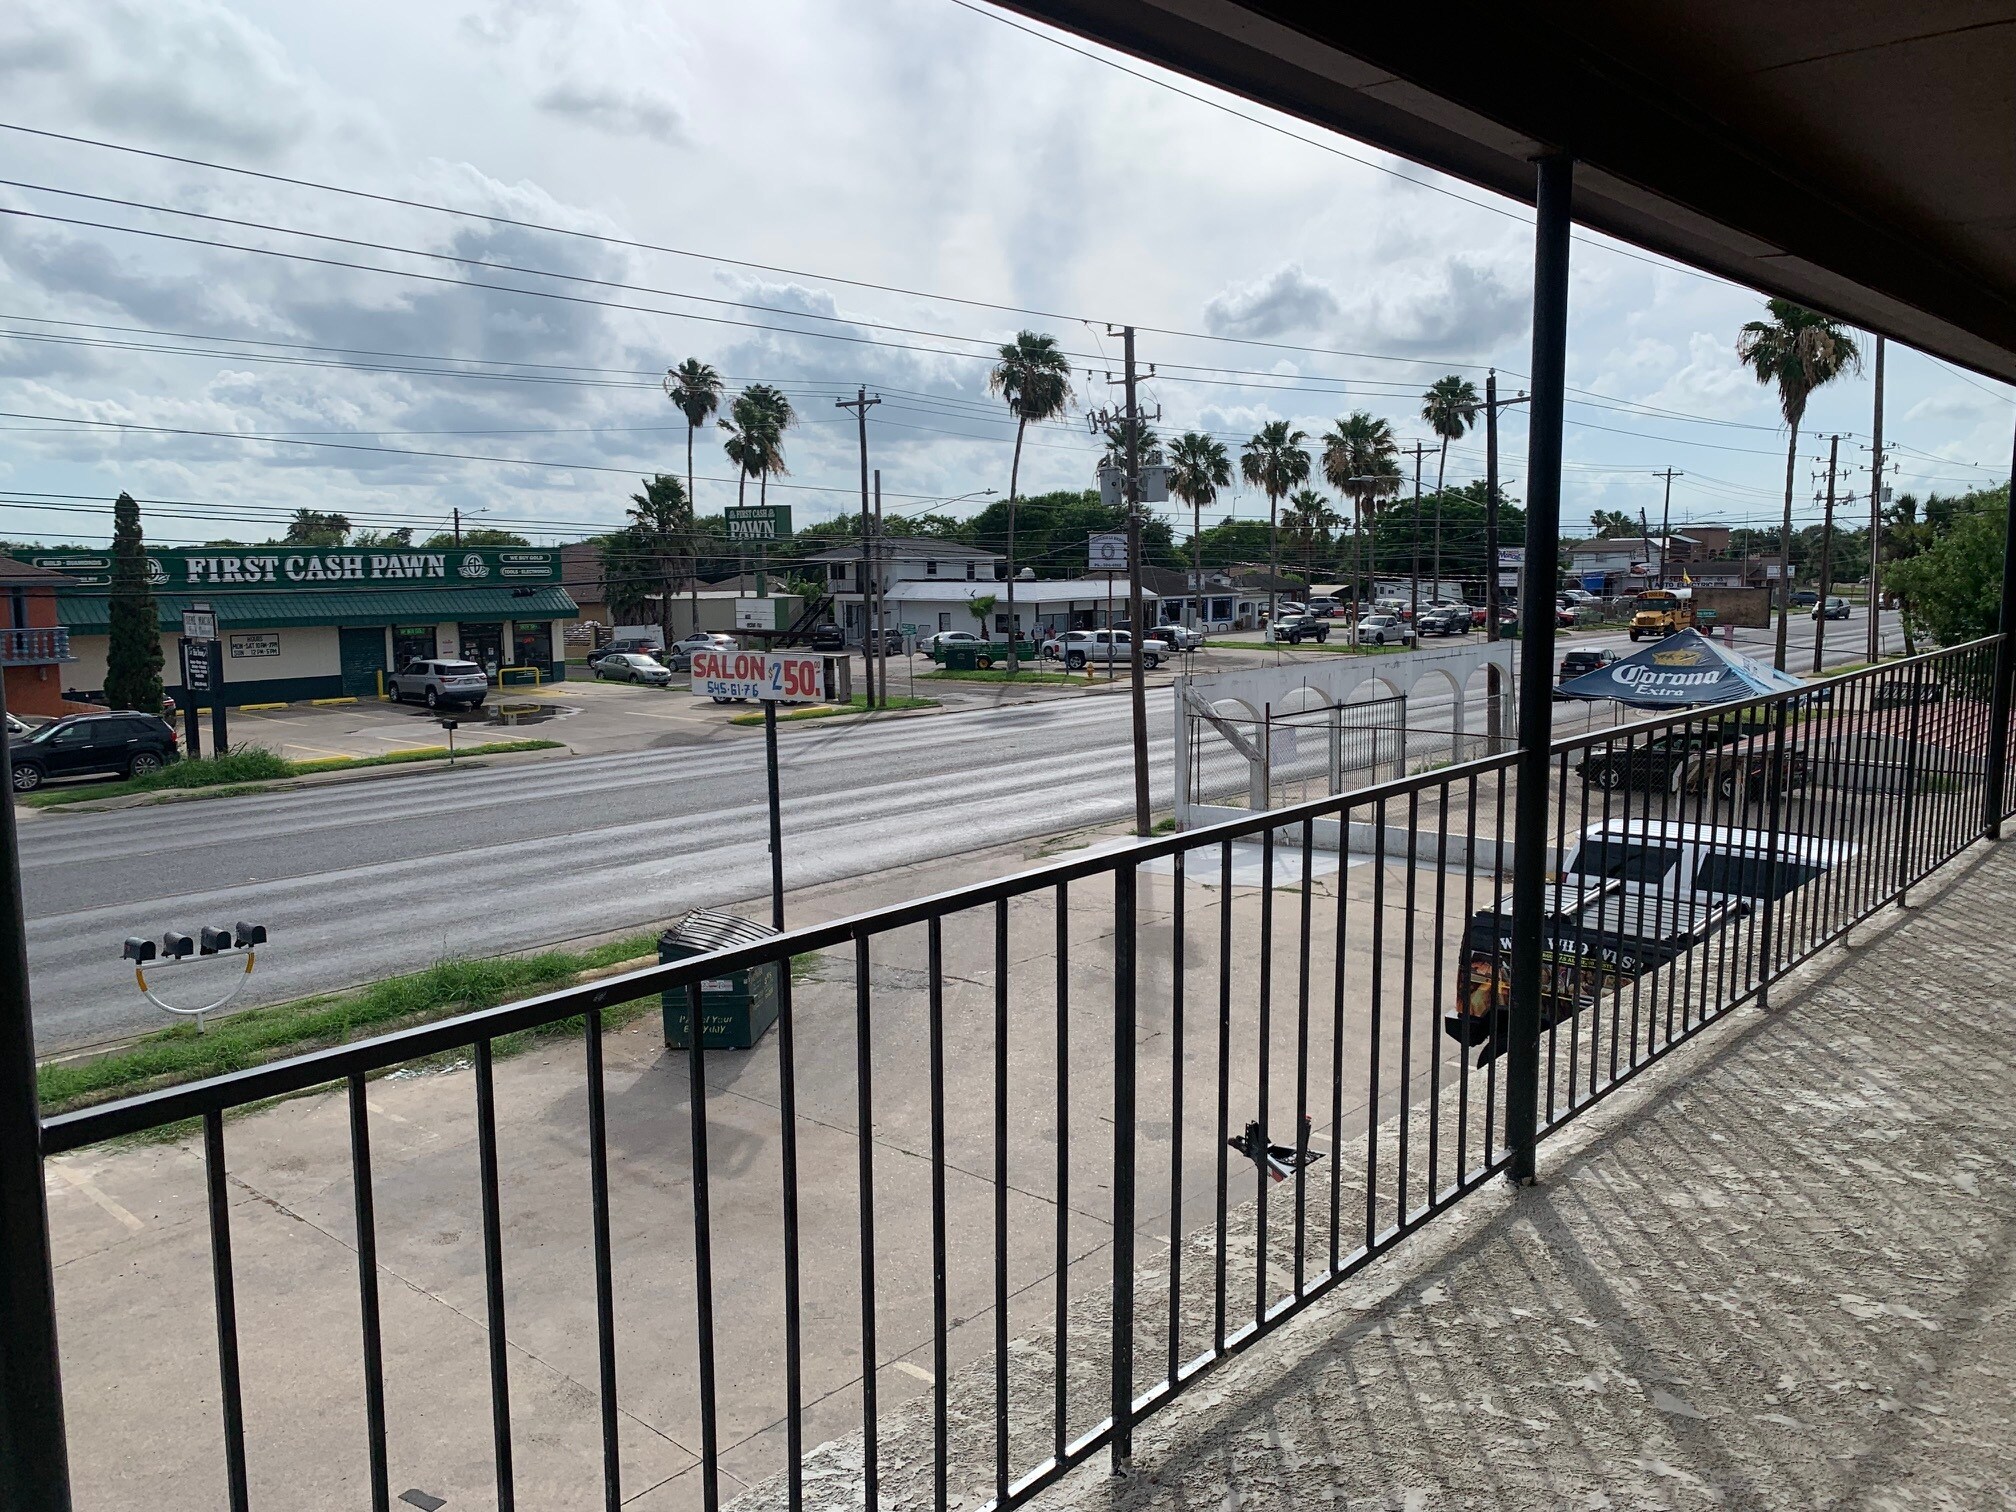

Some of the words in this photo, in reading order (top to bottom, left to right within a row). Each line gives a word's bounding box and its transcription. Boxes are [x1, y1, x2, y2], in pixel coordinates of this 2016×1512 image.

[736, 509, 752, 518] FIRST
[752, 508, 768, 517] CASH
[729, 520, 776, 540] PAWN
[185, 556, 279, 583] FIRST
[285, 555, 365, 581] CASH
[369, 554, 446, 578] PAWN
[693, 653, 765, 680] SALON
[1611, 664, 1721, 688] Corona
[1635, 684, 1684, 696] Extra
